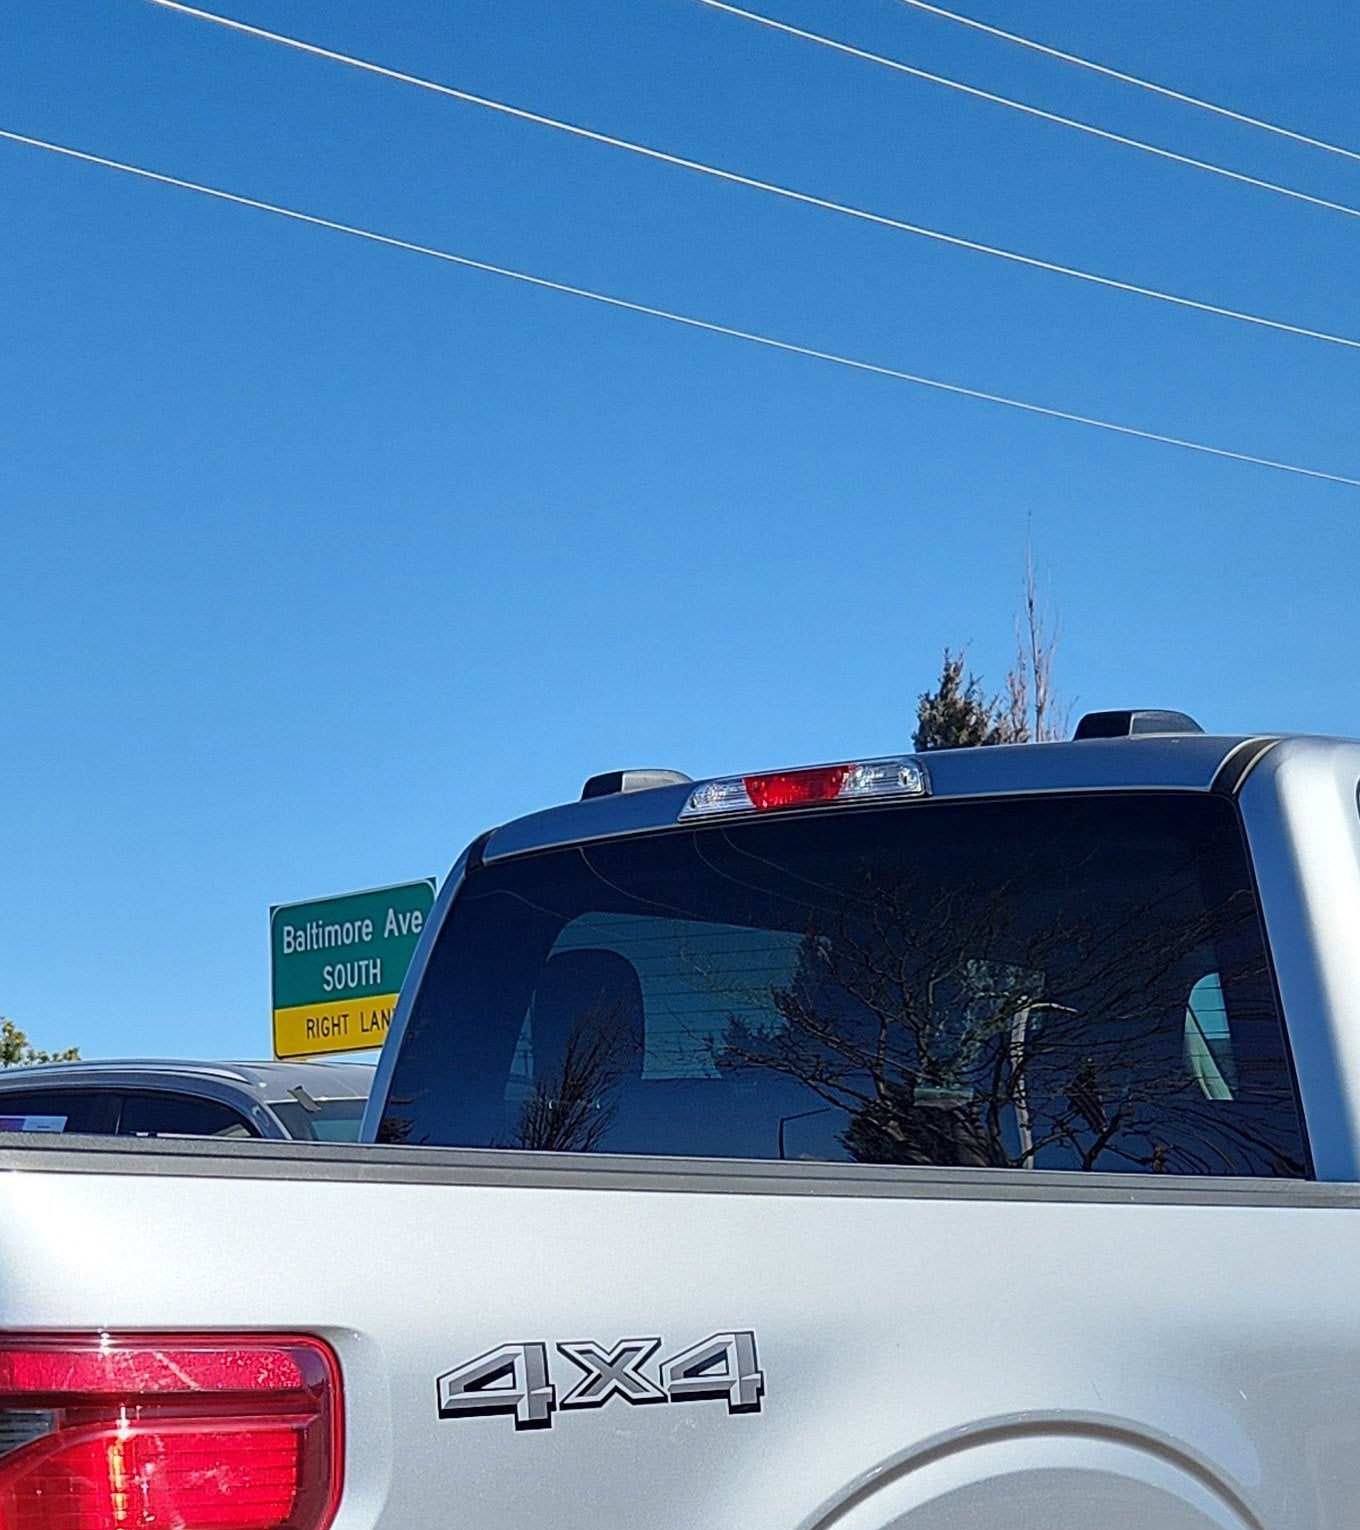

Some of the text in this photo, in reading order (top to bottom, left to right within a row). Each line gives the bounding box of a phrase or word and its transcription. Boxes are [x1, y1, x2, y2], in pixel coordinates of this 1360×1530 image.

[283, 908, 423, 954] Baltimore Ave
[323, 958, 381, 991] SOUTH
[306, 1008, 395, 1039] RIGHT LAN
